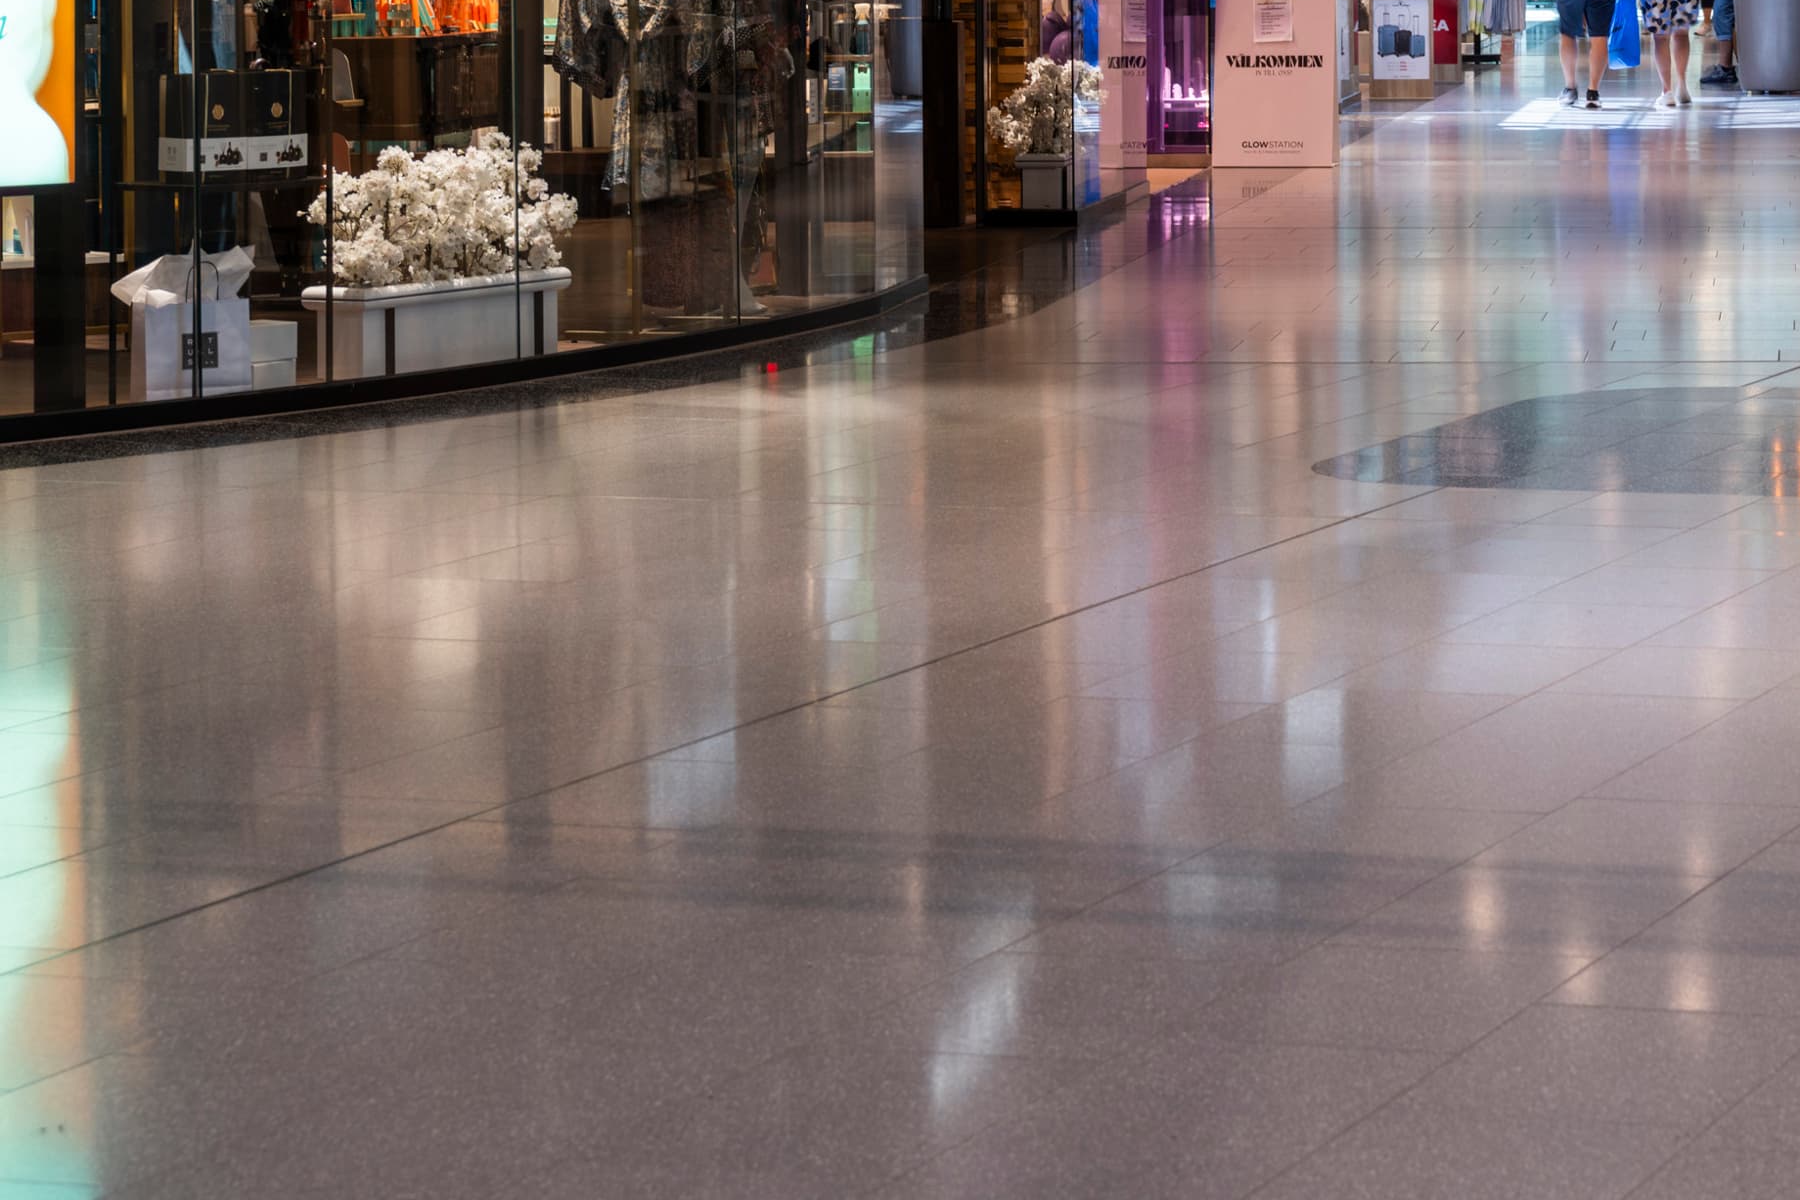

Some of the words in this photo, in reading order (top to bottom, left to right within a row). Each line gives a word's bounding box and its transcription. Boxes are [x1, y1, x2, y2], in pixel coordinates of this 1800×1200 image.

[1432, 19, 1450, 32] EA
[1226, 53, 1324, 69] VÄLKOMMEN
[1241, 141, 1304, 149] GLOWSTATION
